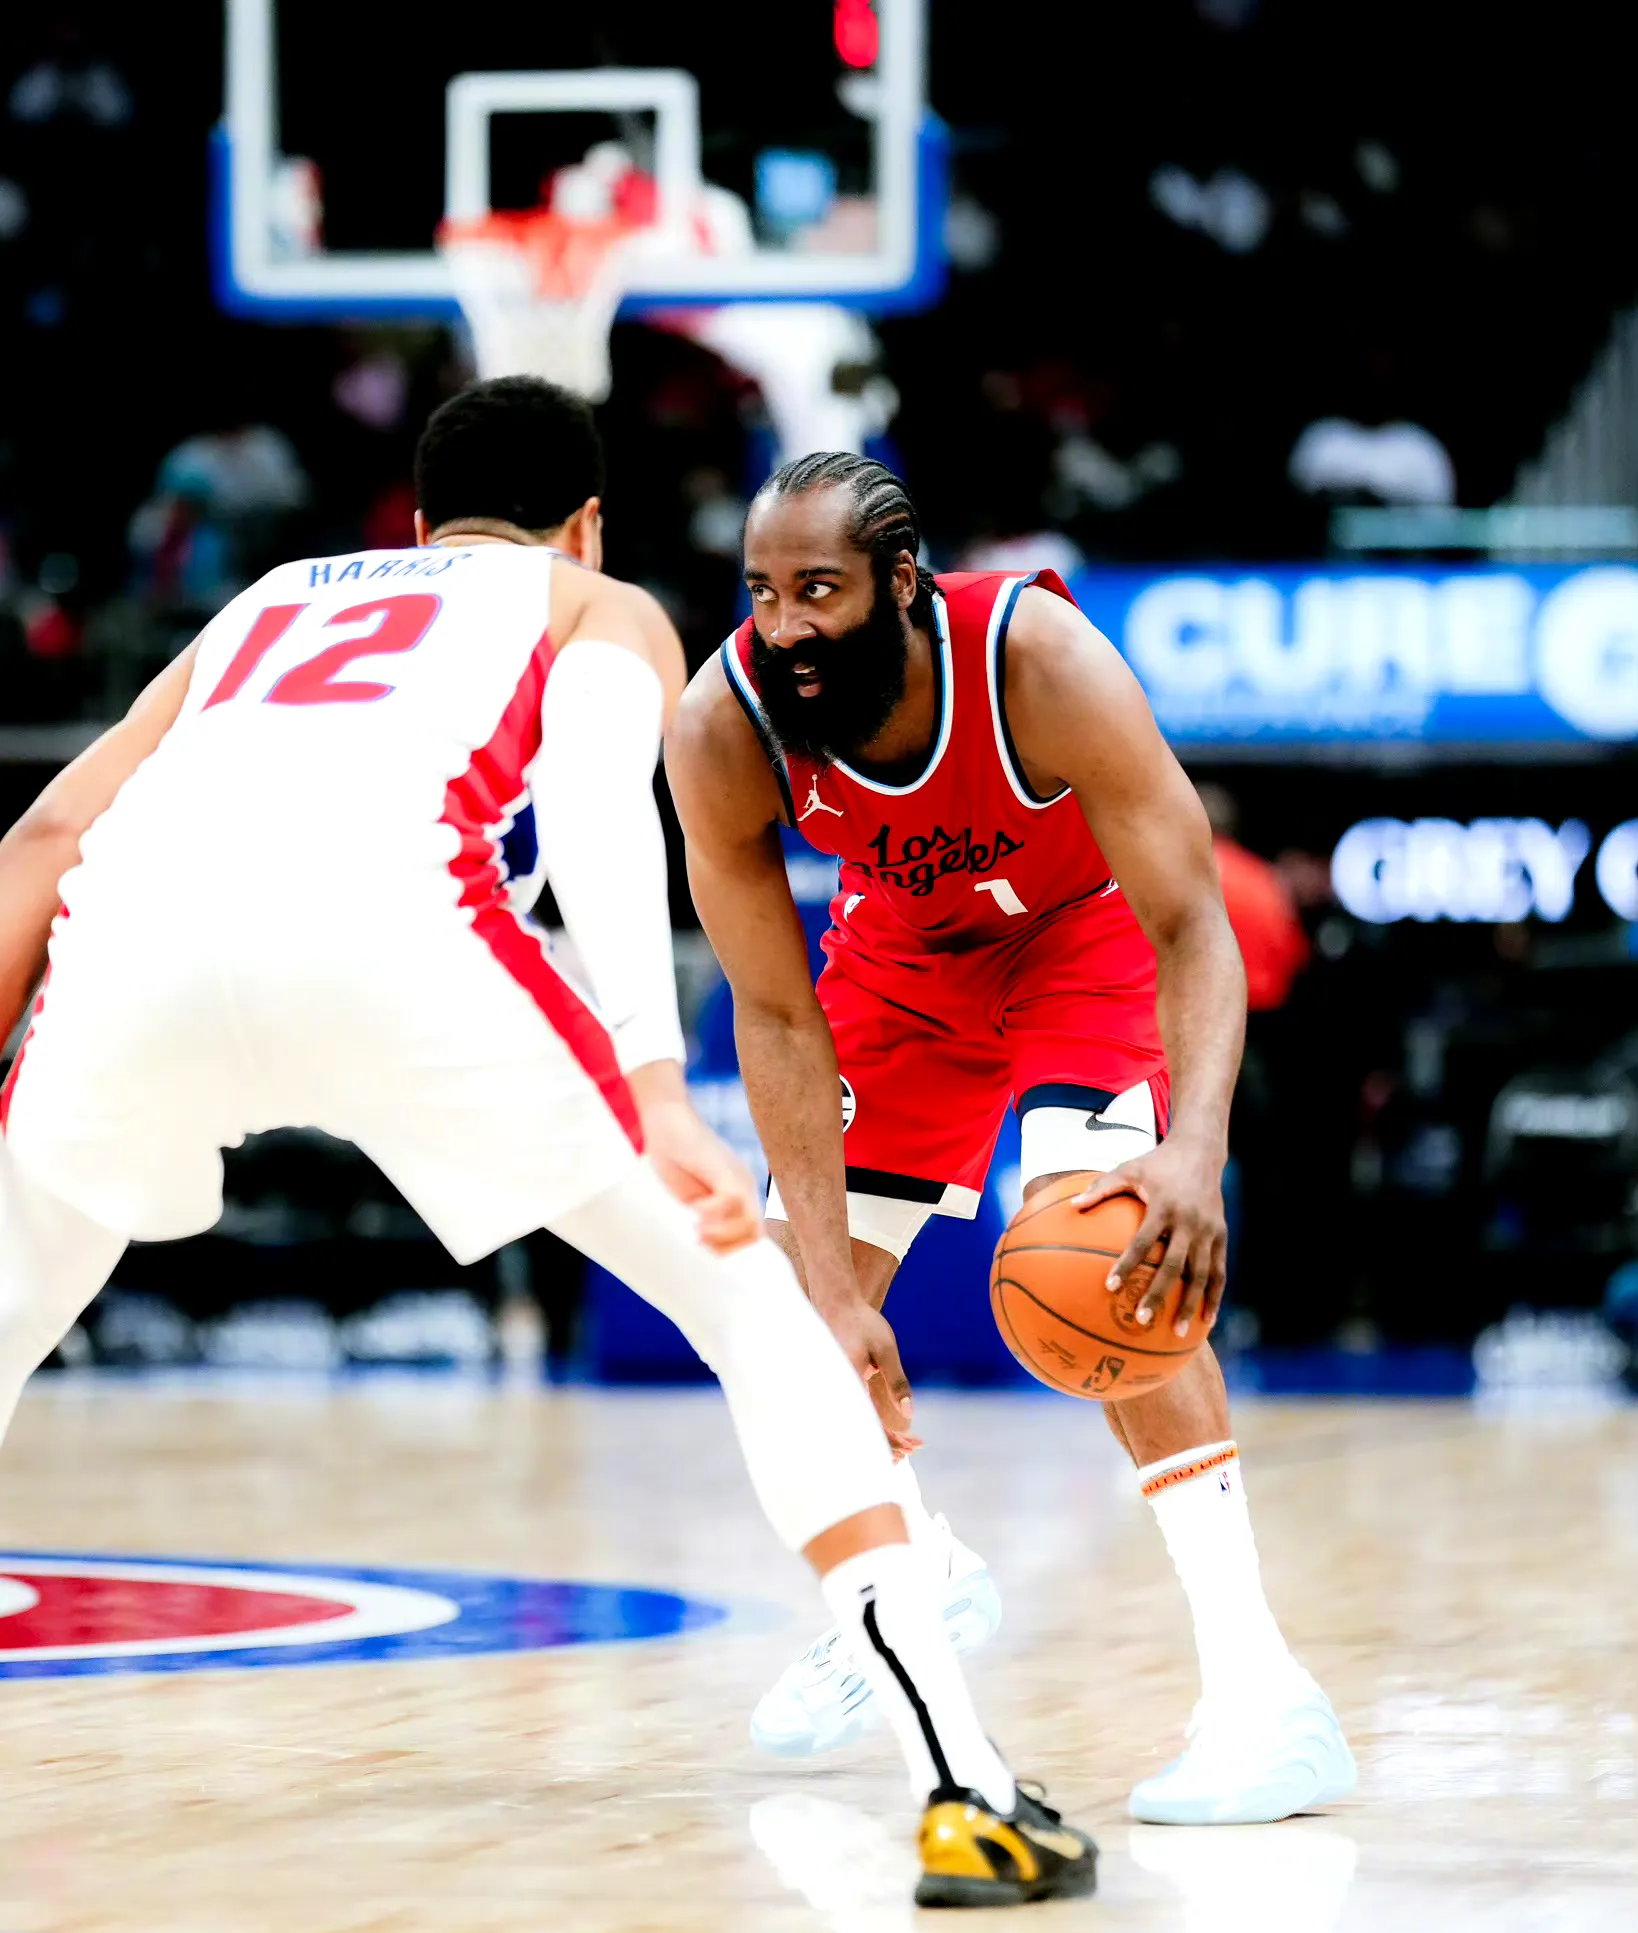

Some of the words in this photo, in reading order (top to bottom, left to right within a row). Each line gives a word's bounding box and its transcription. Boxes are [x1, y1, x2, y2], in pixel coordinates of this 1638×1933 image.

[309, 552, 473, 588] HARRIS
[199, 592, 443, 714] 12
[851, 826, 1025, 896] ngeles
[867, 824, 962, 868] Los
[973, 878, 1029, 916] 1
